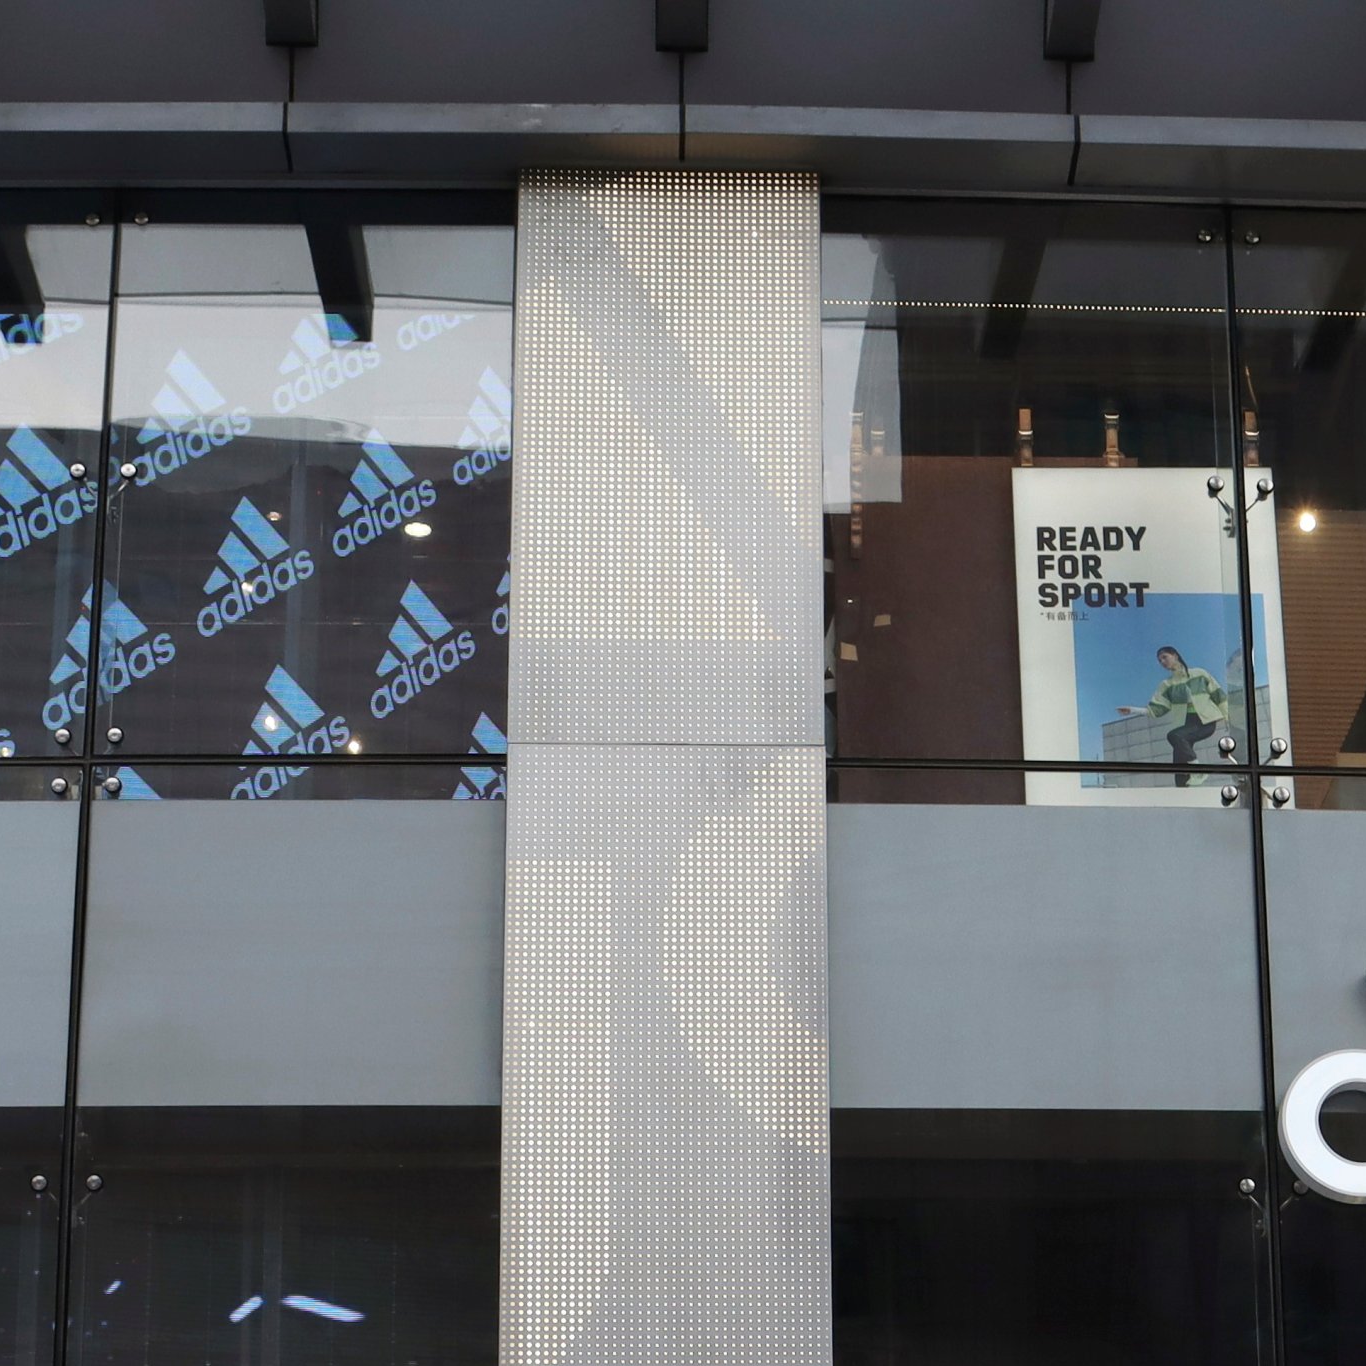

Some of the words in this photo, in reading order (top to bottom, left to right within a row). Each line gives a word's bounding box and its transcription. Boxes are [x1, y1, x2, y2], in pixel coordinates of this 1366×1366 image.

[272, 342, 381, 415] adidas
[128, 404, 251, 487] adidas
[332, 479, 438, 558] adidas
[1037, 526, 1146, 551] READY
[196, 549, 315, 638] adidas
[1037, 554, 1103, 579] FOR
[1038, 582, 1150, 608] SPORT
[369, 630, 476, 720] adidas
